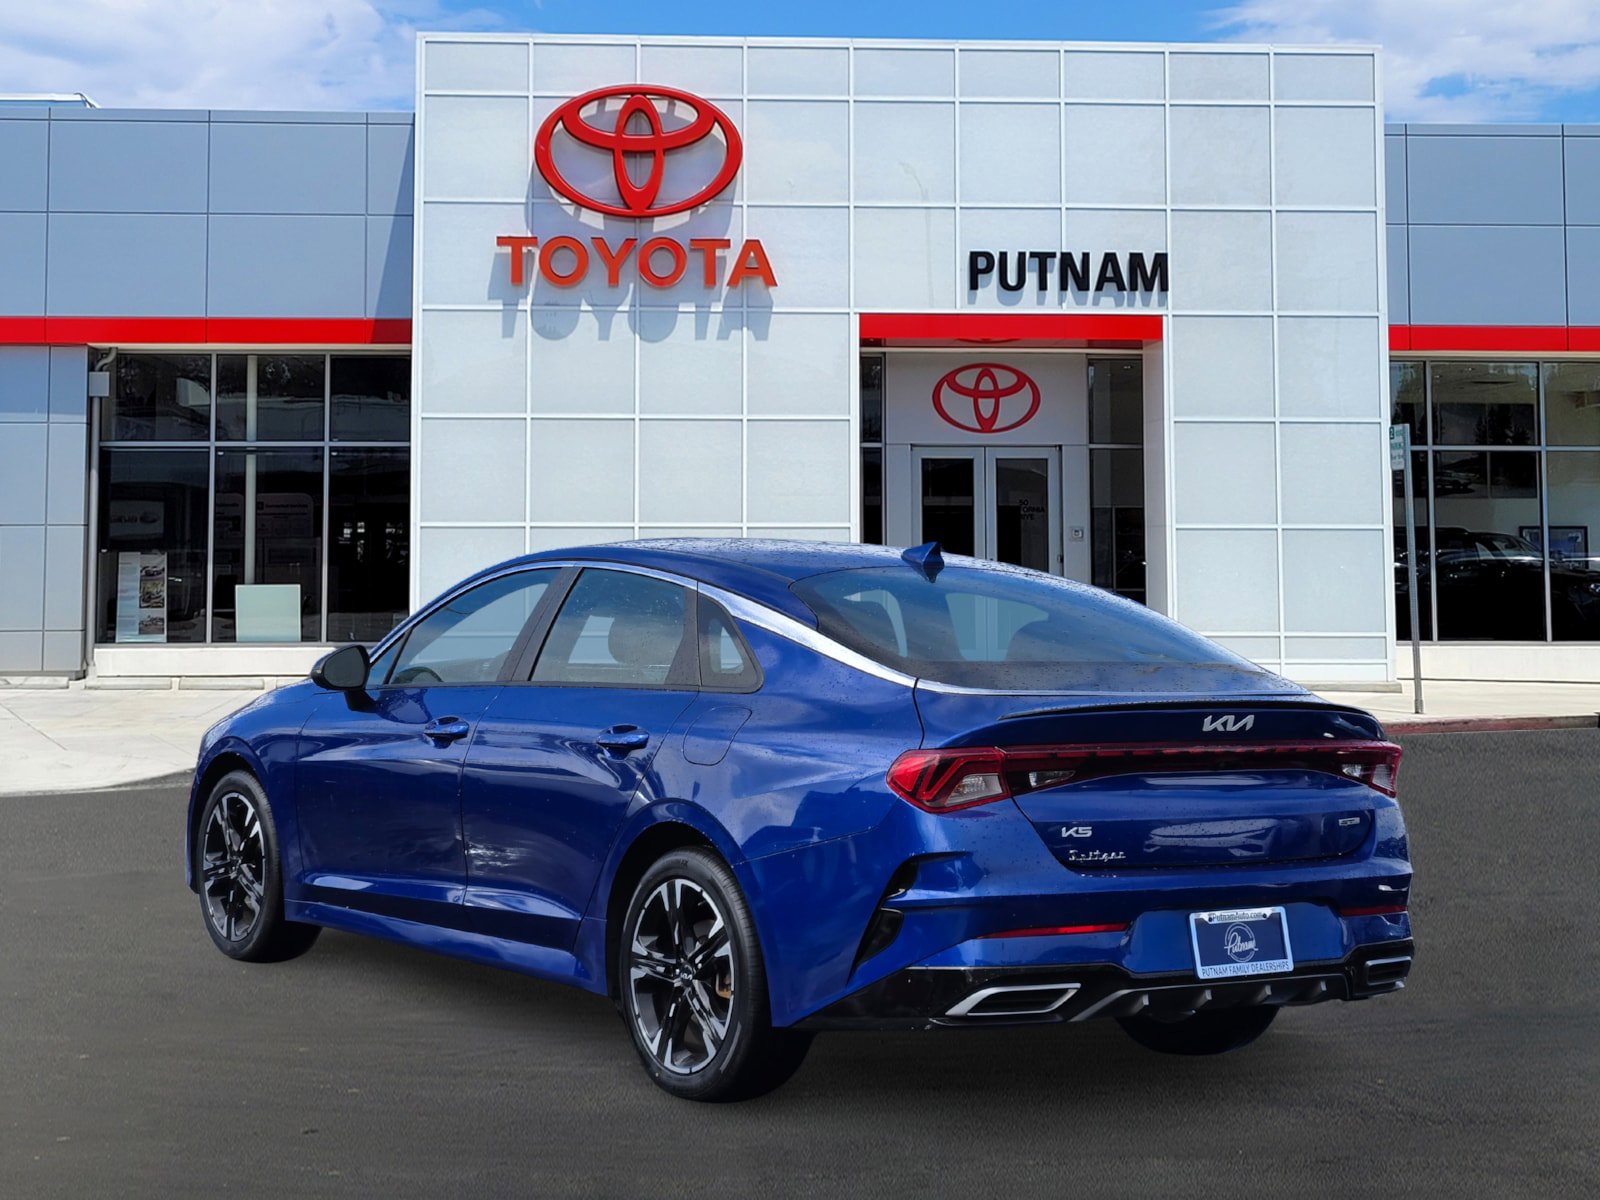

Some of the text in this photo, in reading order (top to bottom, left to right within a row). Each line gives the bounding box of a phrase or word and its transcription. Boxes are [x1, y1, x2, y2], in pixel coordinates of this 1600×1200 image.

[496, 236, 778, 288] TOYOTA
[969, 251, 1169, 292] PUTNAM
[1202, 714, 1255, 732] KIA
[1061, 826, 1093, 838] K5
[1224, 932, 1259, 956] Putnam
[1202, 961, 1289, 977] PUTNAM FAMILY DEALERSHIPS
